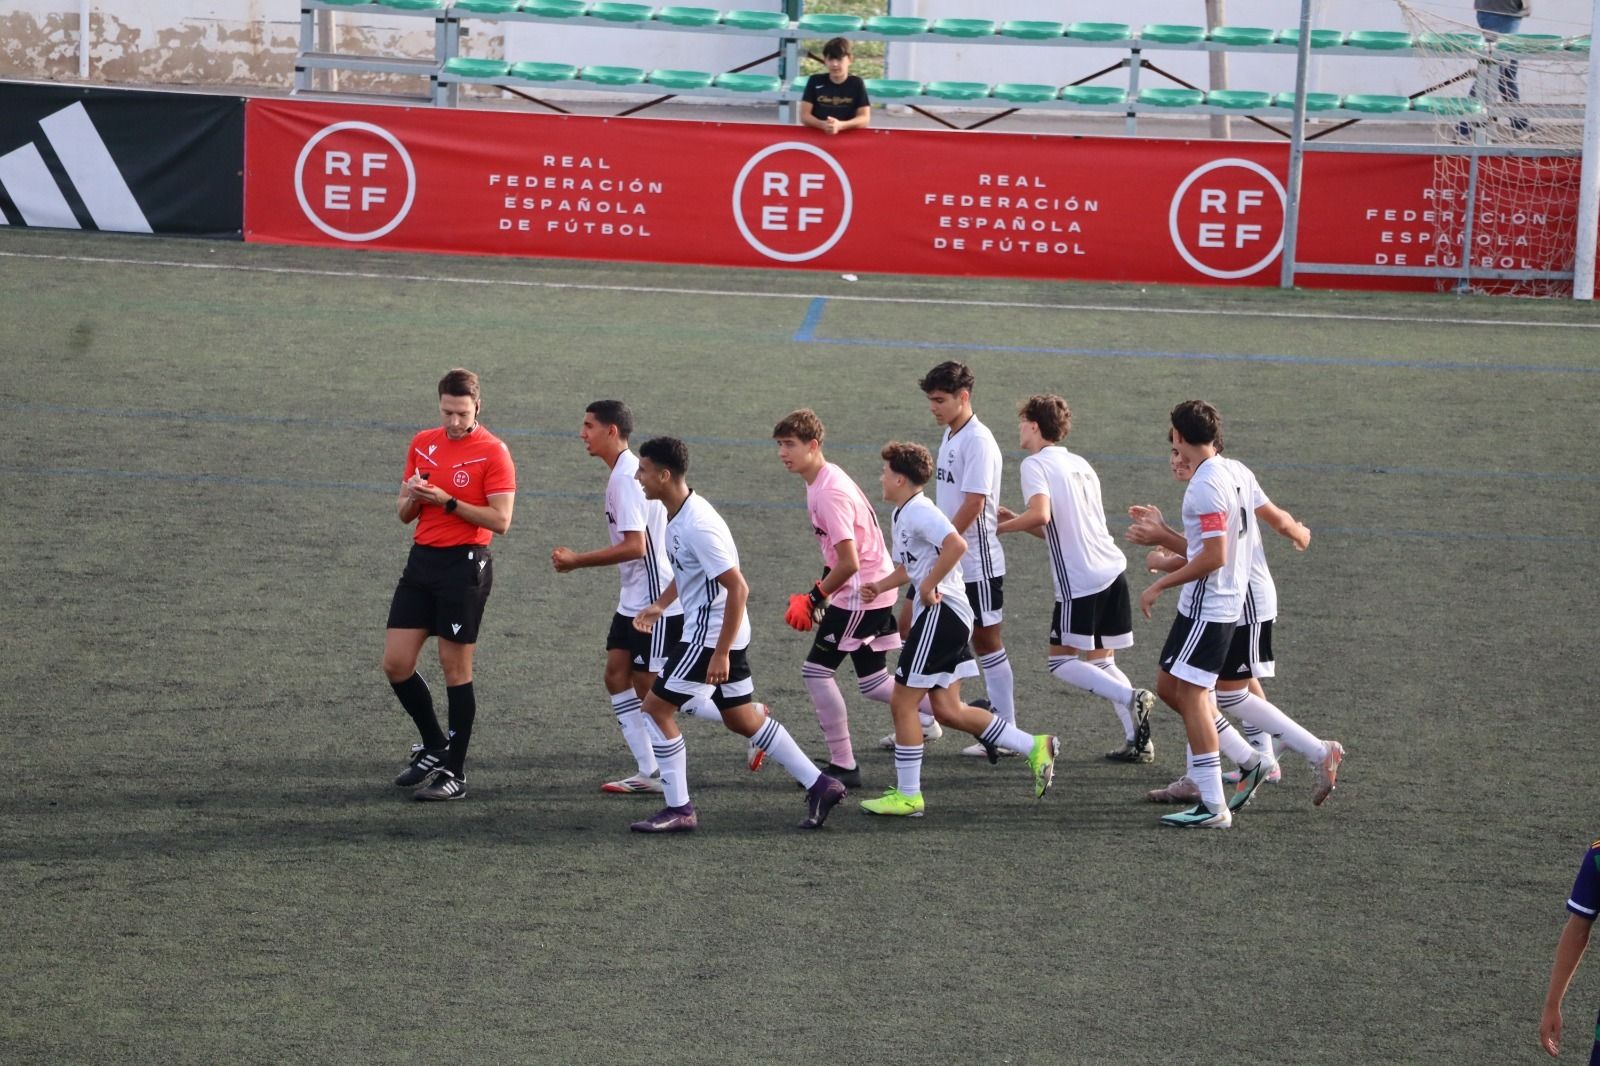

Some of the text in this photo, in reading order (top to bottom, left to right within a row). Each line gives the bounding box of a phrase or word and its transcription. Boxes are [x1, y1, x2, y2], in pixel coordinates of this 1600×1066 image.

[325, 150, 388, 176] RF
[543, 155, 610, 170] REAL
[489, 174, 662, 194] FEDERACIÓN
[762, 171, 826, 198] RF
[979, 173, 1047, 189] REAL
[324, 184, 387, 211] EF
[504, 195, 646, 216] ESPAÑOLA
[924, 193, 1098, 212] FEDERACIÓN
[1199, 188, 1264, 214] RF
[499, 217, 651, 238] DE FÚTBOL
[761, 205, 824, 232] EF
[939, 215, 1082, 233] ESPAÑOLA
[934, 236, 1086, 255] DE FÚTBOL
[1198, 222, 1262, 249] EF
[1375, 252, 1532, 269] DE FÚBOL
